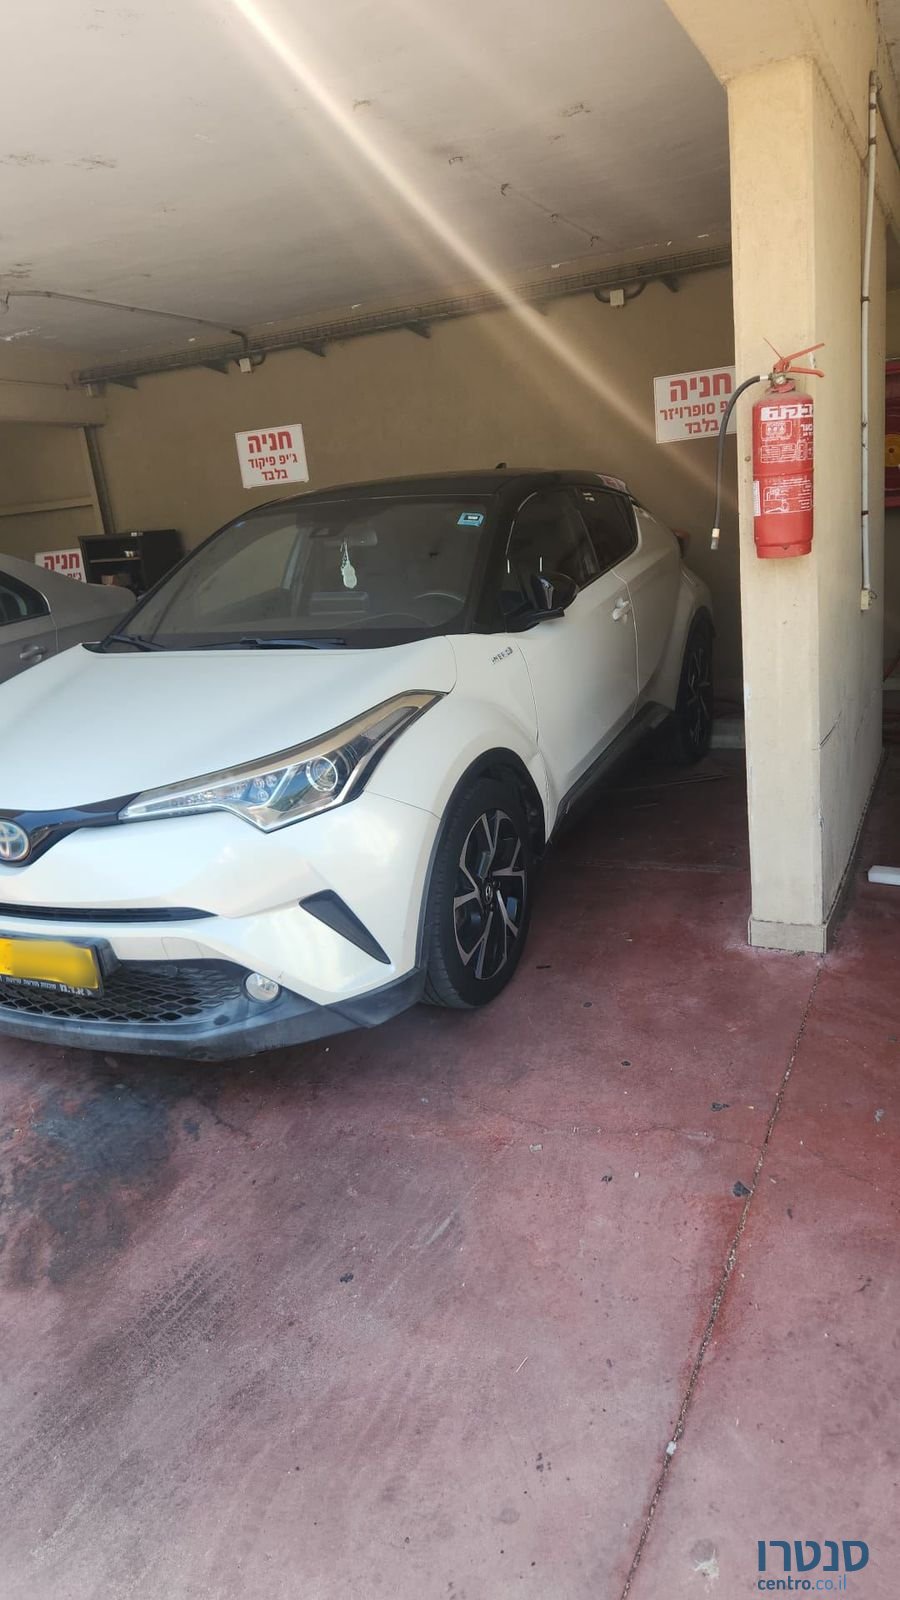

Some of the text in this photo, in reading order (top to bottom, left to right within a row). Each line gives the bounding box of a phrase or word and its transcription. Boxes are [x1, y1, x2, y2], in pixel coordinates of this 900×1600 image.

[670, 373, 732, 402] חניה
[660, 402, 716, 421] סופרויזר
[769, 405, 813, 419] בקה
[685, 418, 720, 434] בלבד
[248, 431, 292, 453] חניה
[248, 453, 297, 470] ג'יפ פיקוד
[262, 468, 288, 481] בלבד
[44, 553, 80, 570] חניה
